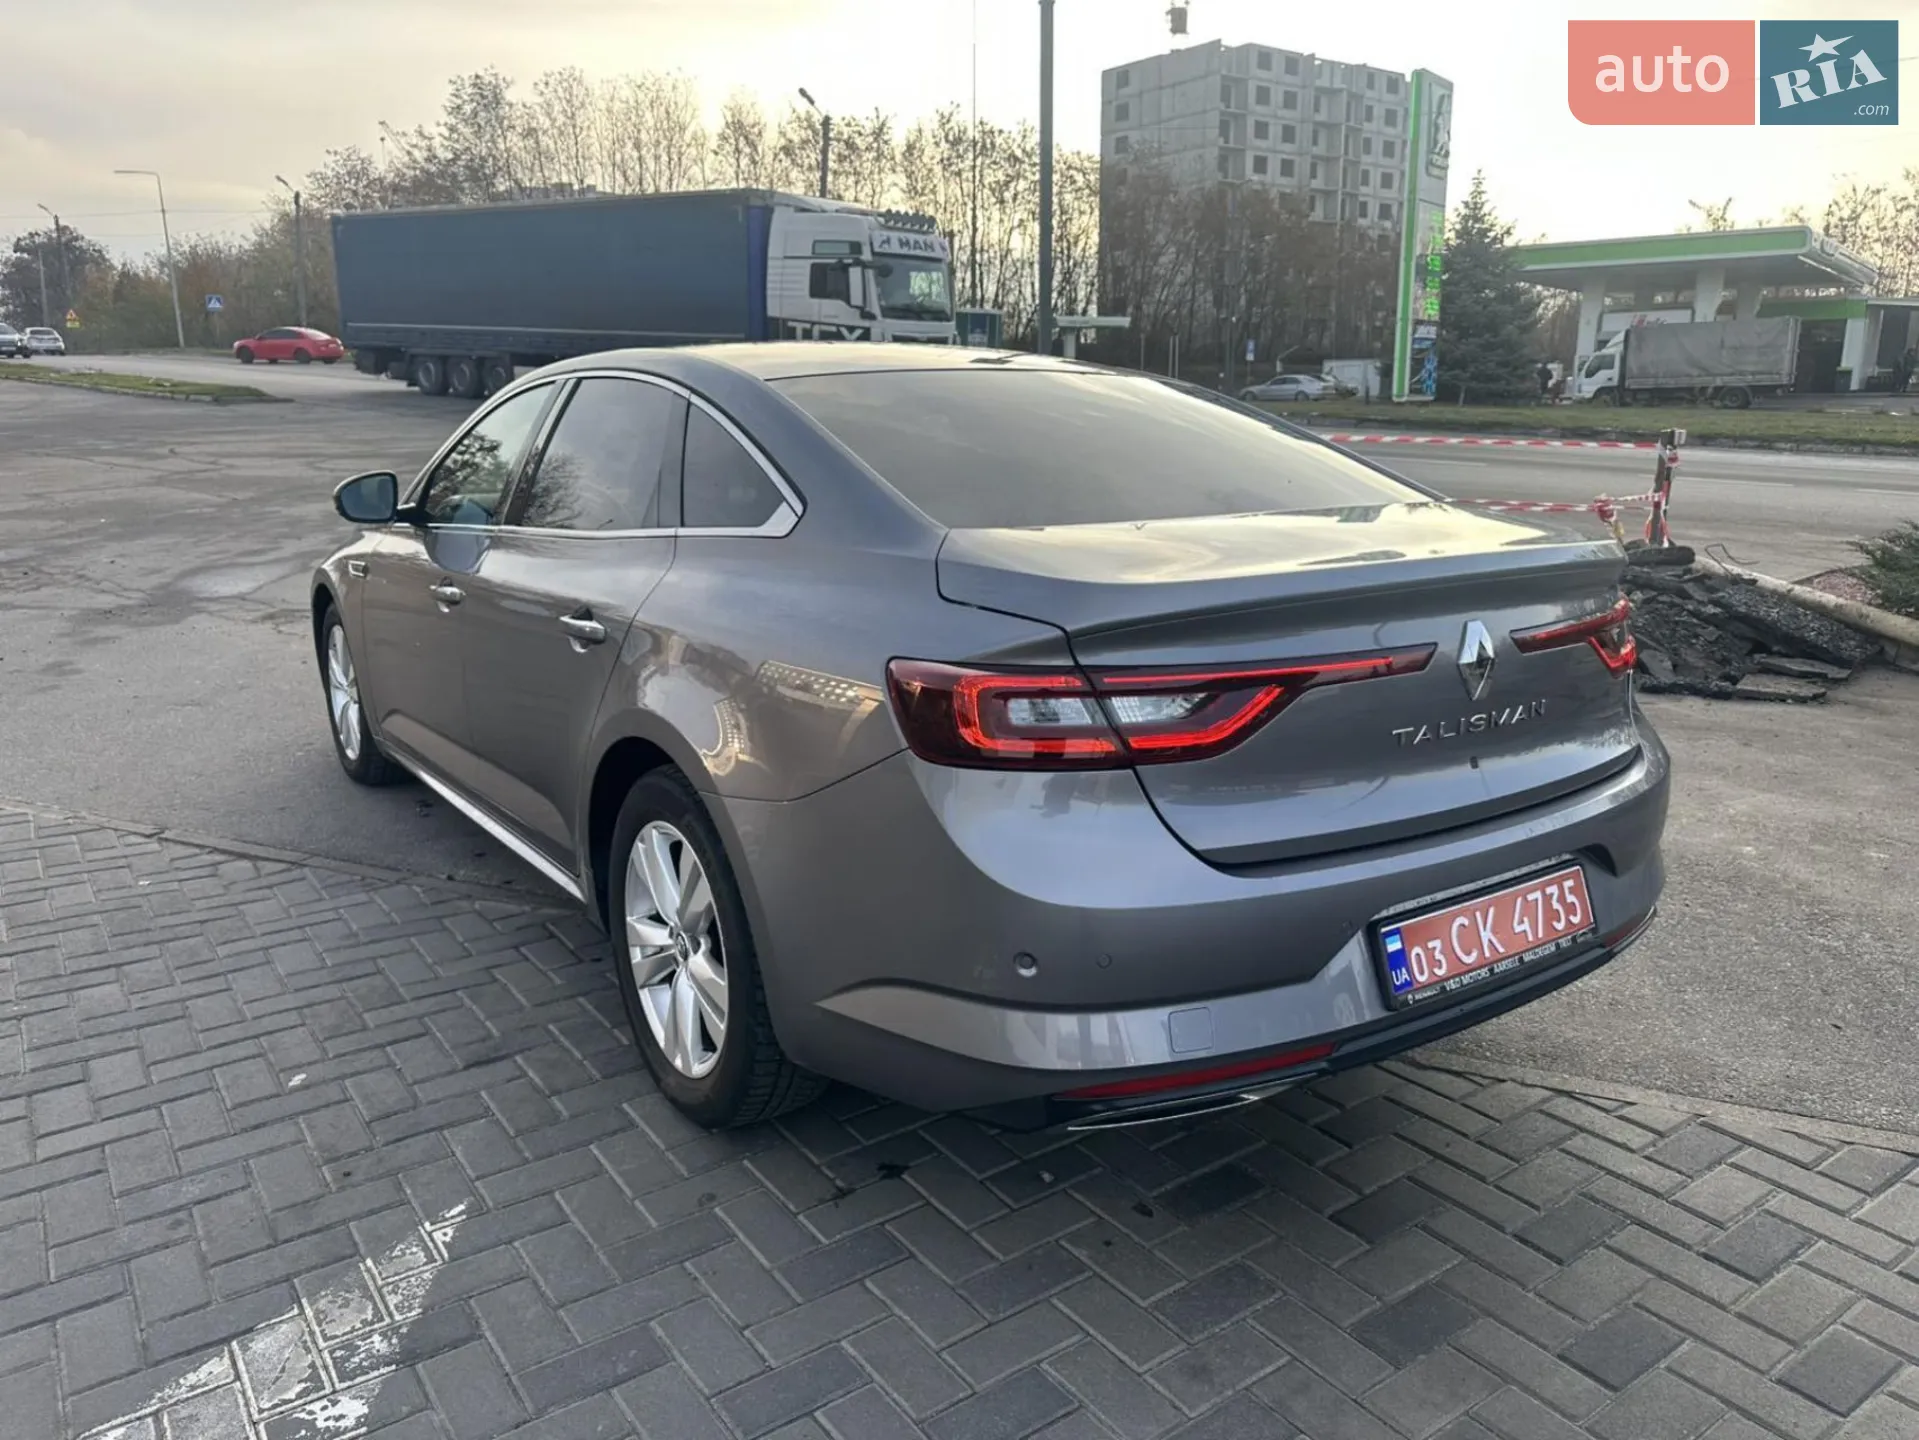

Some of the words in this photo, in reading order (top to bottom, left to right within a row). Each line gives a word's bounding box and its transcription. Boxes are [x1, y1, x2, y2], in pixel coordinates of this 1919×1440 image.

[898, 236, 936, 253] MAN
[1392, 699, 1546, 746] TALISMAN
[1411, 939, 1448, 983] 03
[1450, 905, 1506, 965] CK
[1512, 878, 1583, 942] 4735
[1392, 966, 1411, 986] UA
[1461, 967, 1491, 986] MOTORS
